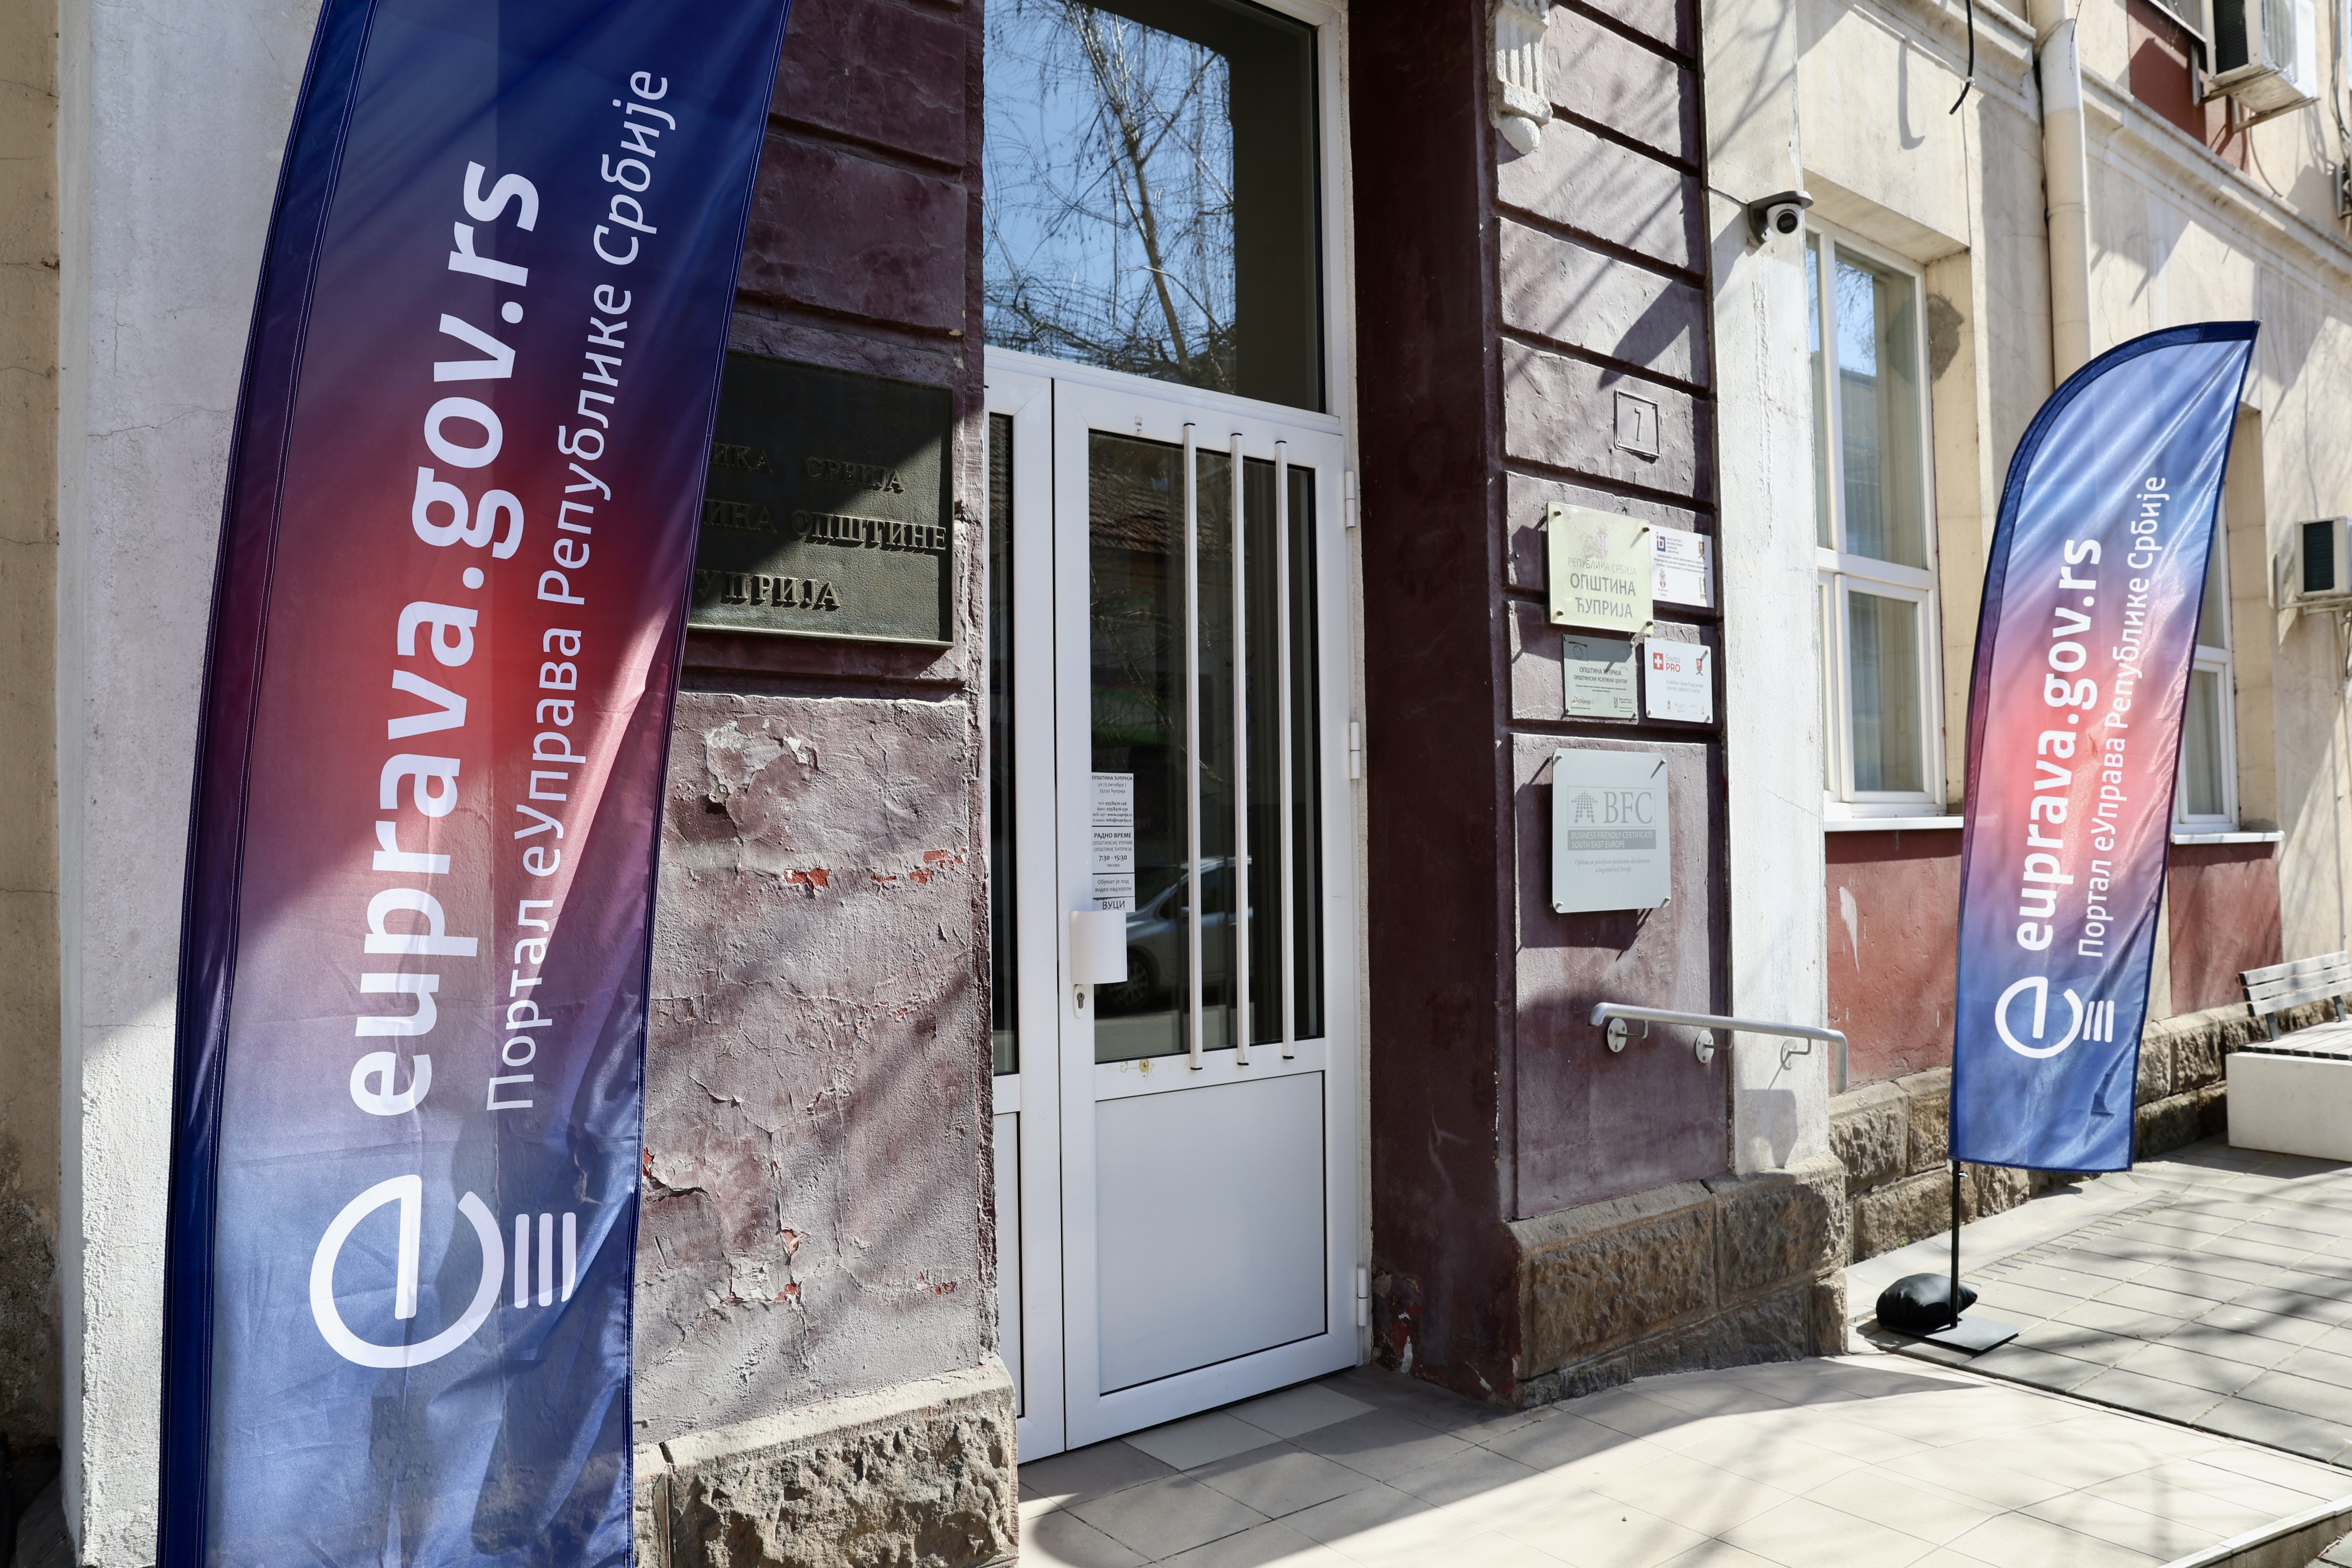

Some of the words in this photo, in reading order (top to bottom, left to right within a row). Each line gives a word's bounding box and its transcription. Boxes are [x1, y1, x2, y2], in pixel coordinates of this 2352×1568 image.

[593, 70, 675, 266] Србије
[537, 283, 631, 605] Републике
[805, 456, 904, 492] СРБИЈА
[790, 511, 946, 551] ОПШТИНЕ
[2127, 477, 2170, 569] Србије
[695, 569, 841, 607] УПРИЈА
[1568, 557, 1611, 572] РЕПУБЛИКА
[1612, 563, 1637, 576] СРБИЈА
[1570, 573, 1636, 596] ОПШТИНА
[349, 161, 540, 1116] euprava.gov.rs
[1574, 597, 1633, 619] ЋУПРИЈА
[1665, 654, 1681, 663] Swiss
[1666, 662, 1681, 672] PRO
[2105, 577, 2150, 729] Републике
[514, 628, 586, 877] еУправа
[2016, 539, 2102, 951] euprava.gov.rs
[1603, 791, 1653, 824] BFC
[2090, 738, 2127, 851] еУправа
[1102, 900, 1125, 910] ВУЦИ
[2078, 860, 2113, 957] Портал
[486, 899, 553, 1110] Портал
